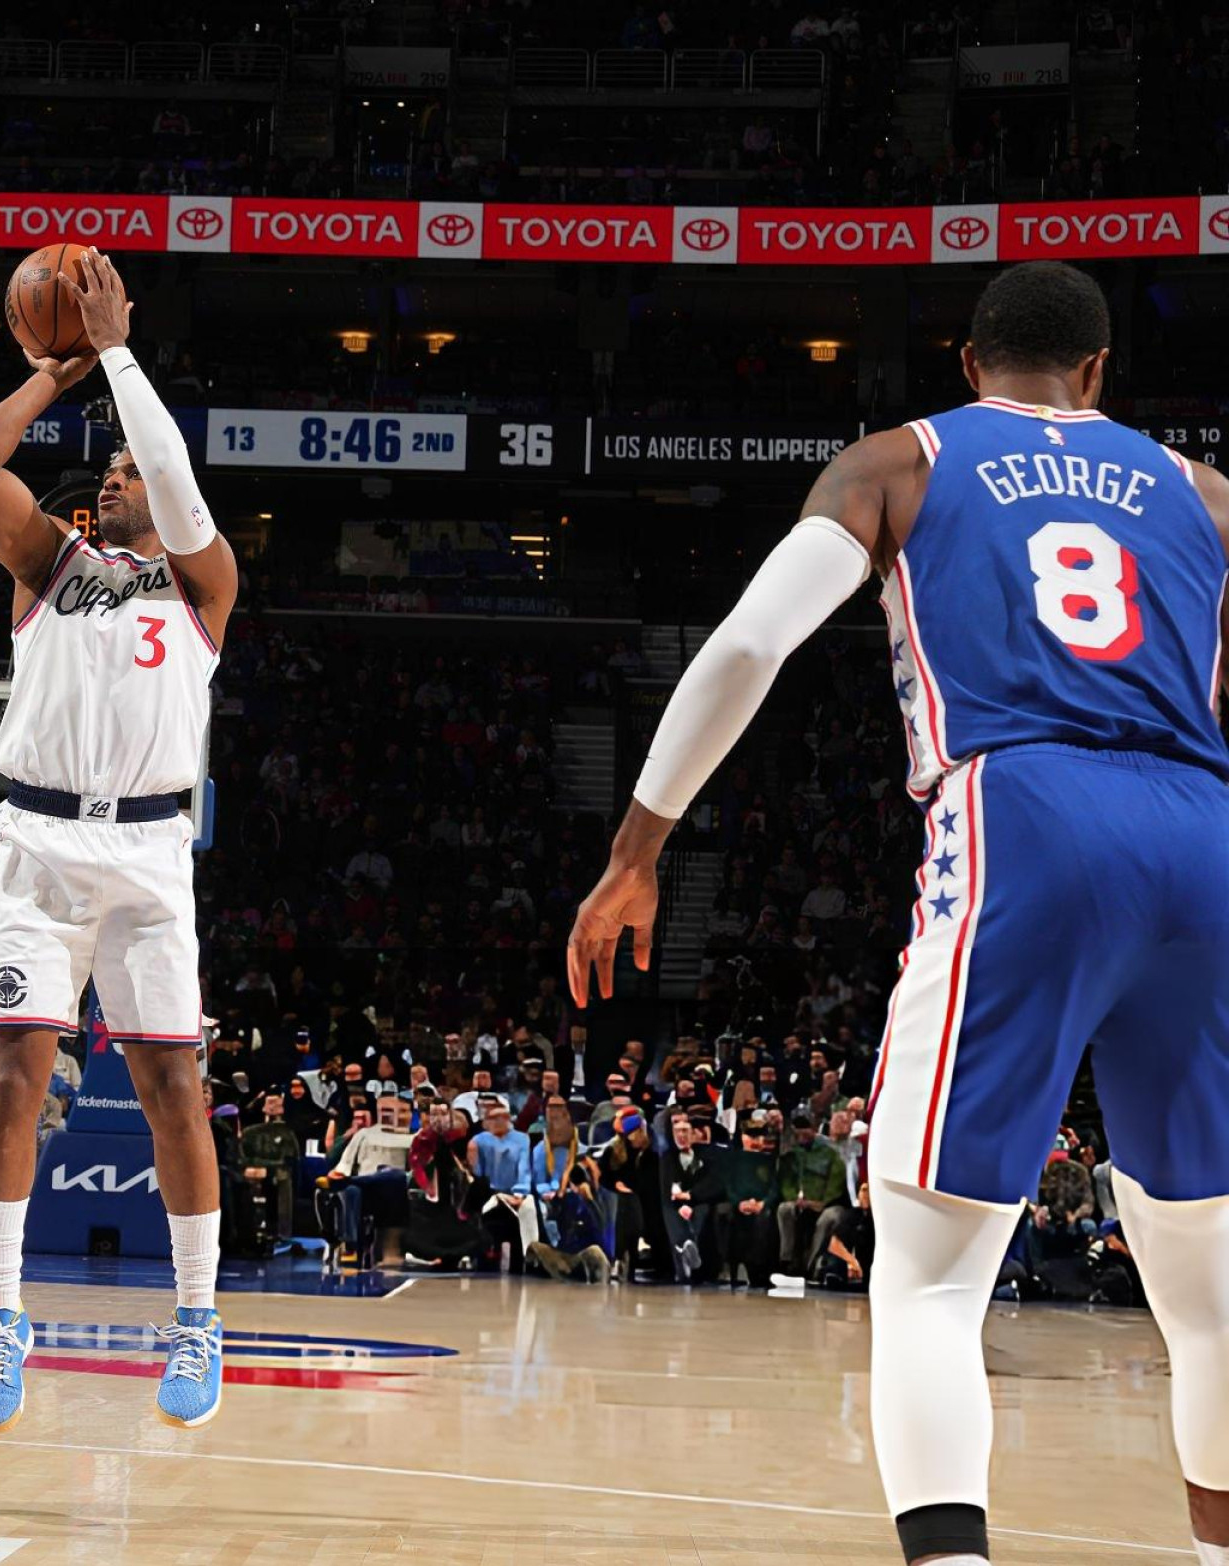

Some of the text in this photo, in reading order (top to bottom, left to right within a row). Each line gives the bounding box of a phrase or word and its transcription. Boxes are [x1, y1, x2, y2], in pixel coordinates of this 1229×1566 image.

[246, 211, 403, 244] TOYOTA
[497, 217, 657, 249] TOYOTA
[753, 221, 916, 252] TOYOTA
[1014, 211, 1182, 247] TOYOTA
[21, 420, 61, 444] ERS
[223, 417, 455, 463] 13 8:46 2ND
[499, 423, 553, 467] 36
[1163, 428, 1188, 444] 33
[1198, 427, 1221, 443] 10
[604, 435, 845, 463] LOS ANGELES CLIPPERS
[1203, 452, 1216, 465] 0
[976, 454, 1156, 517] GEORGE
[56, 567, 172, 618] Clippers
[1027, 522, 1144, 661] 8
[134, 616, 167, 669] 3
[86, 801, 111, 818] LA
